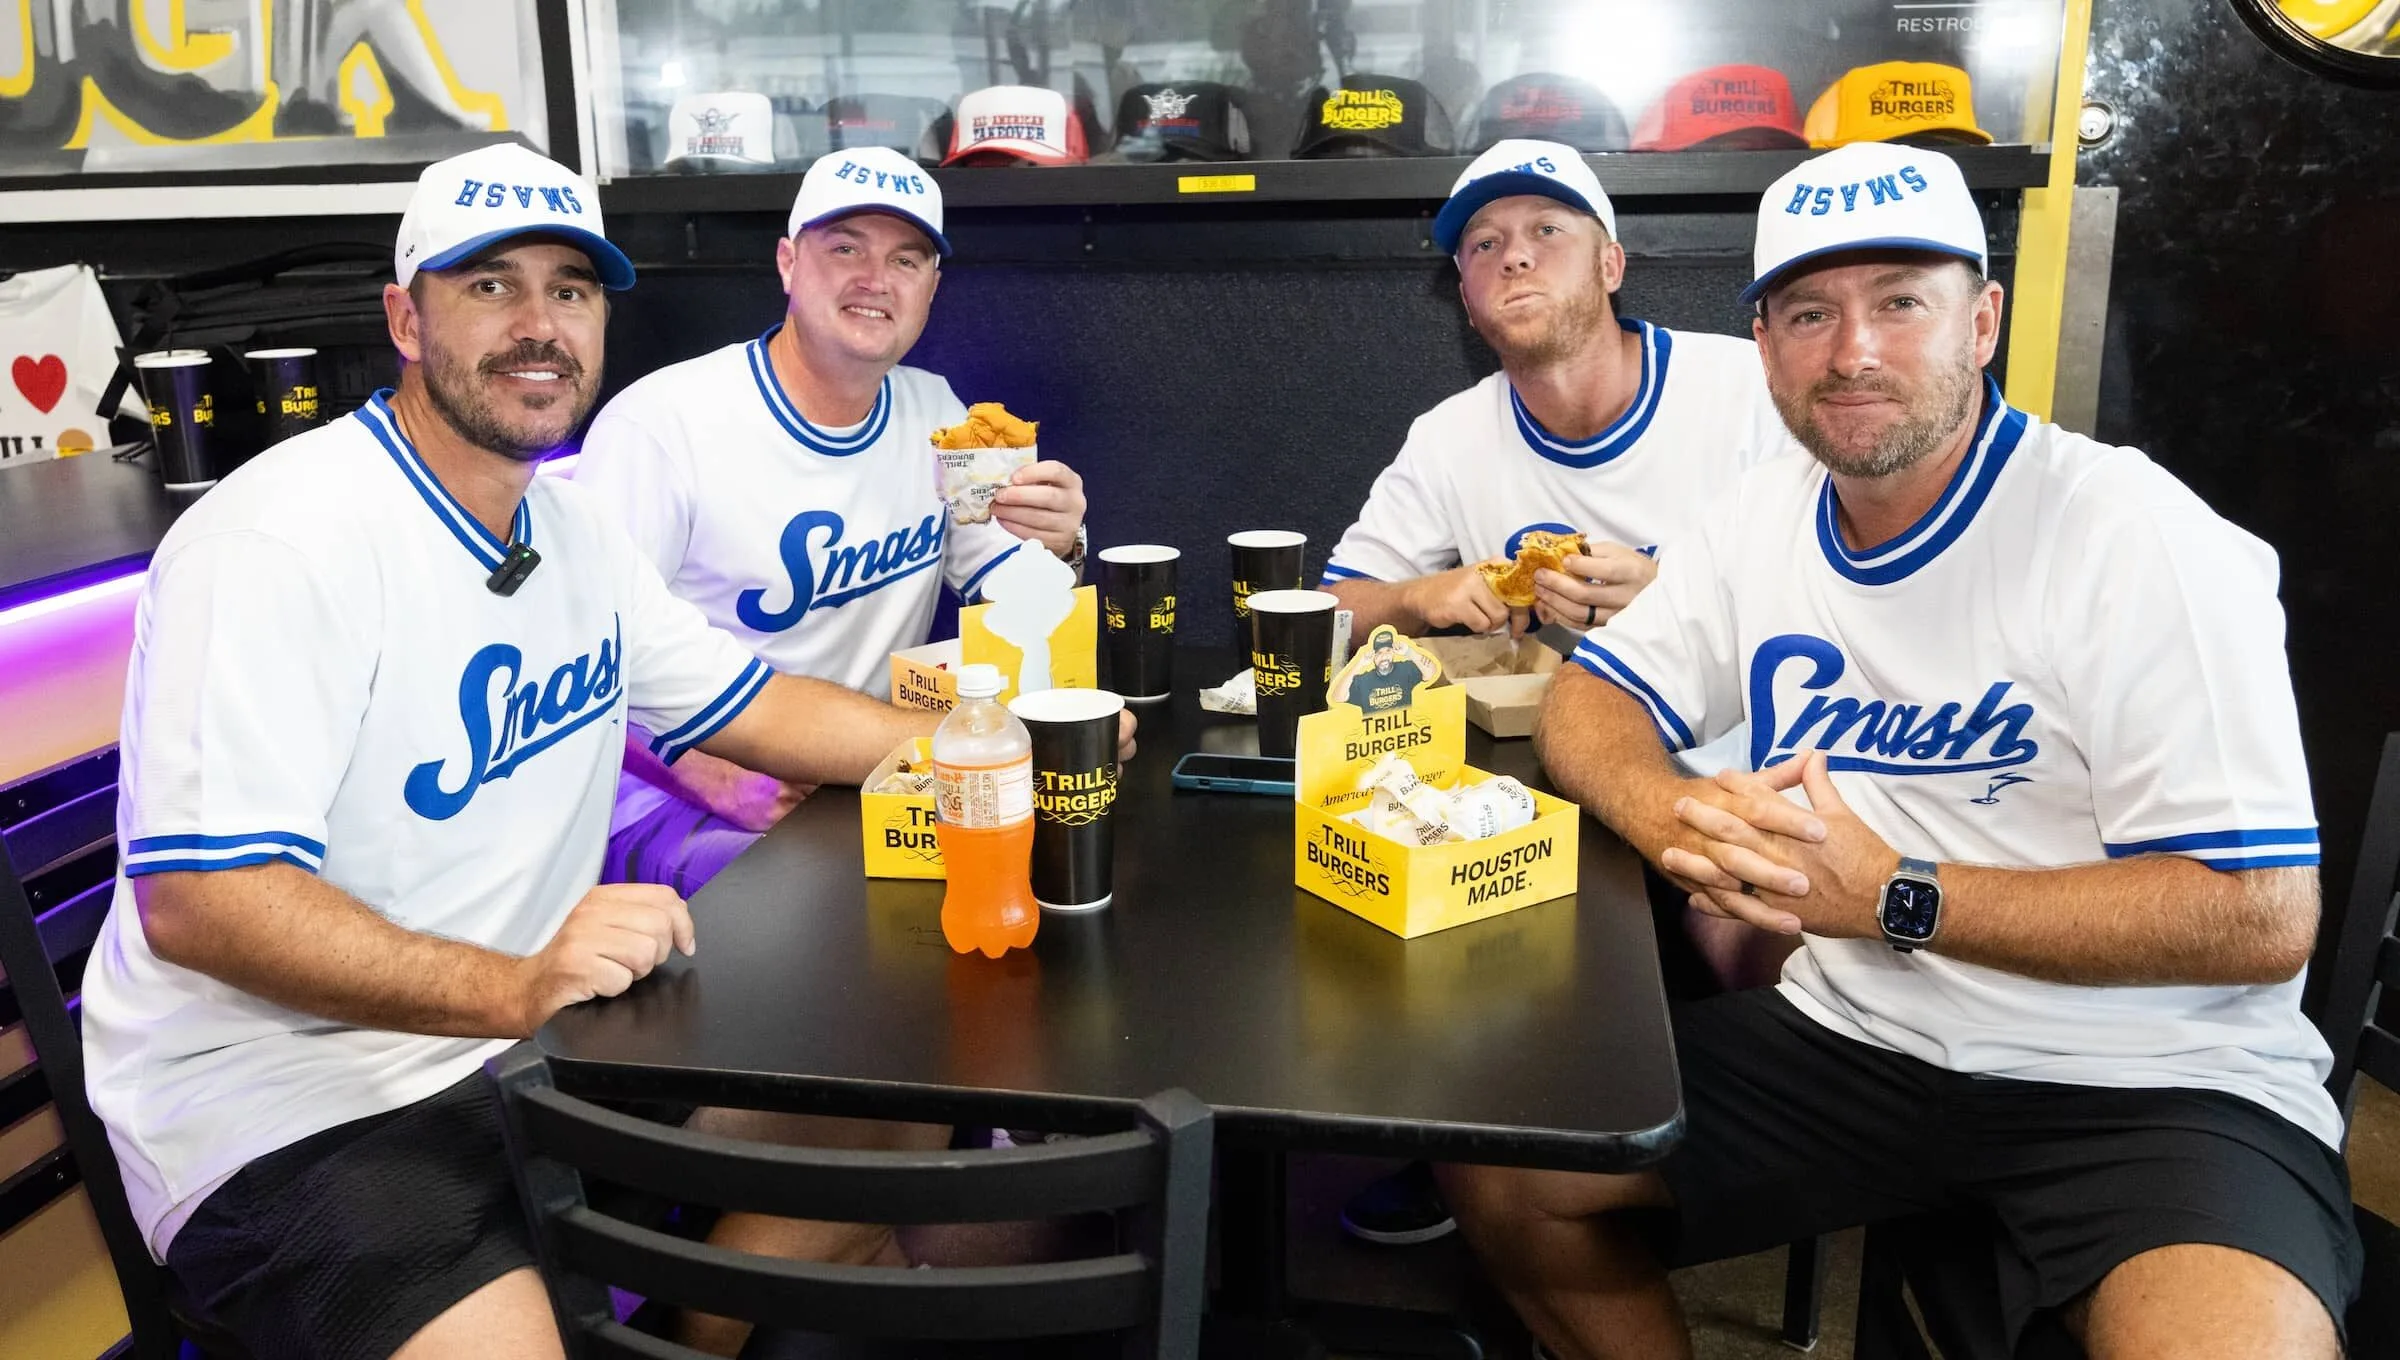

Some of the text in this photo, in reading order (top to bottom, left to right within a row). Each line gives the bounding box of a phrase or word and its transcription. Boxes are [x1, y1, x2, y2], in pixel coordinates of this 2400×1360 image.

[1338, 89, 1381, 105] TRILL
[1709, 79, 1760, 96] TRILL
[1888, 80, 1940, 97] TRILL
[992, 115, 1045, 126] AMERICAN
[1322, 106, 1403, 124] BURGERS
[1691, 99, 1777, 116] BURGERS
[1870, 99, 1955, 117] BURGERS
[973, 125, 1046, 141] TAKEOVER
[834, 159, 925, 196] SMASH
[1785, 165, 1928, 216] SMASH
[455, 178, 582, 214] SMASH
[908, 668, 940, 694] TRILL
[1375, 686, 1396, 696] TRILL
[899, 684, 953, 712] BURGERS
[1369, 693, 1403, 707] BURGERS
[1750, 633, 2039, 776] Smash
[1361, 709, 1413, 736] TRILL
[1345, 725, 1433, 761] BURGERS
[1040, 766, 1110, 792] TRILL
[1321, 823, 1371, 864] TRILL
[1306, 841, 1391, 897] BURGERS
[1450, 837, 1553, 887] HOUSTON
[1466, 870, 1533, 906] MADE.
